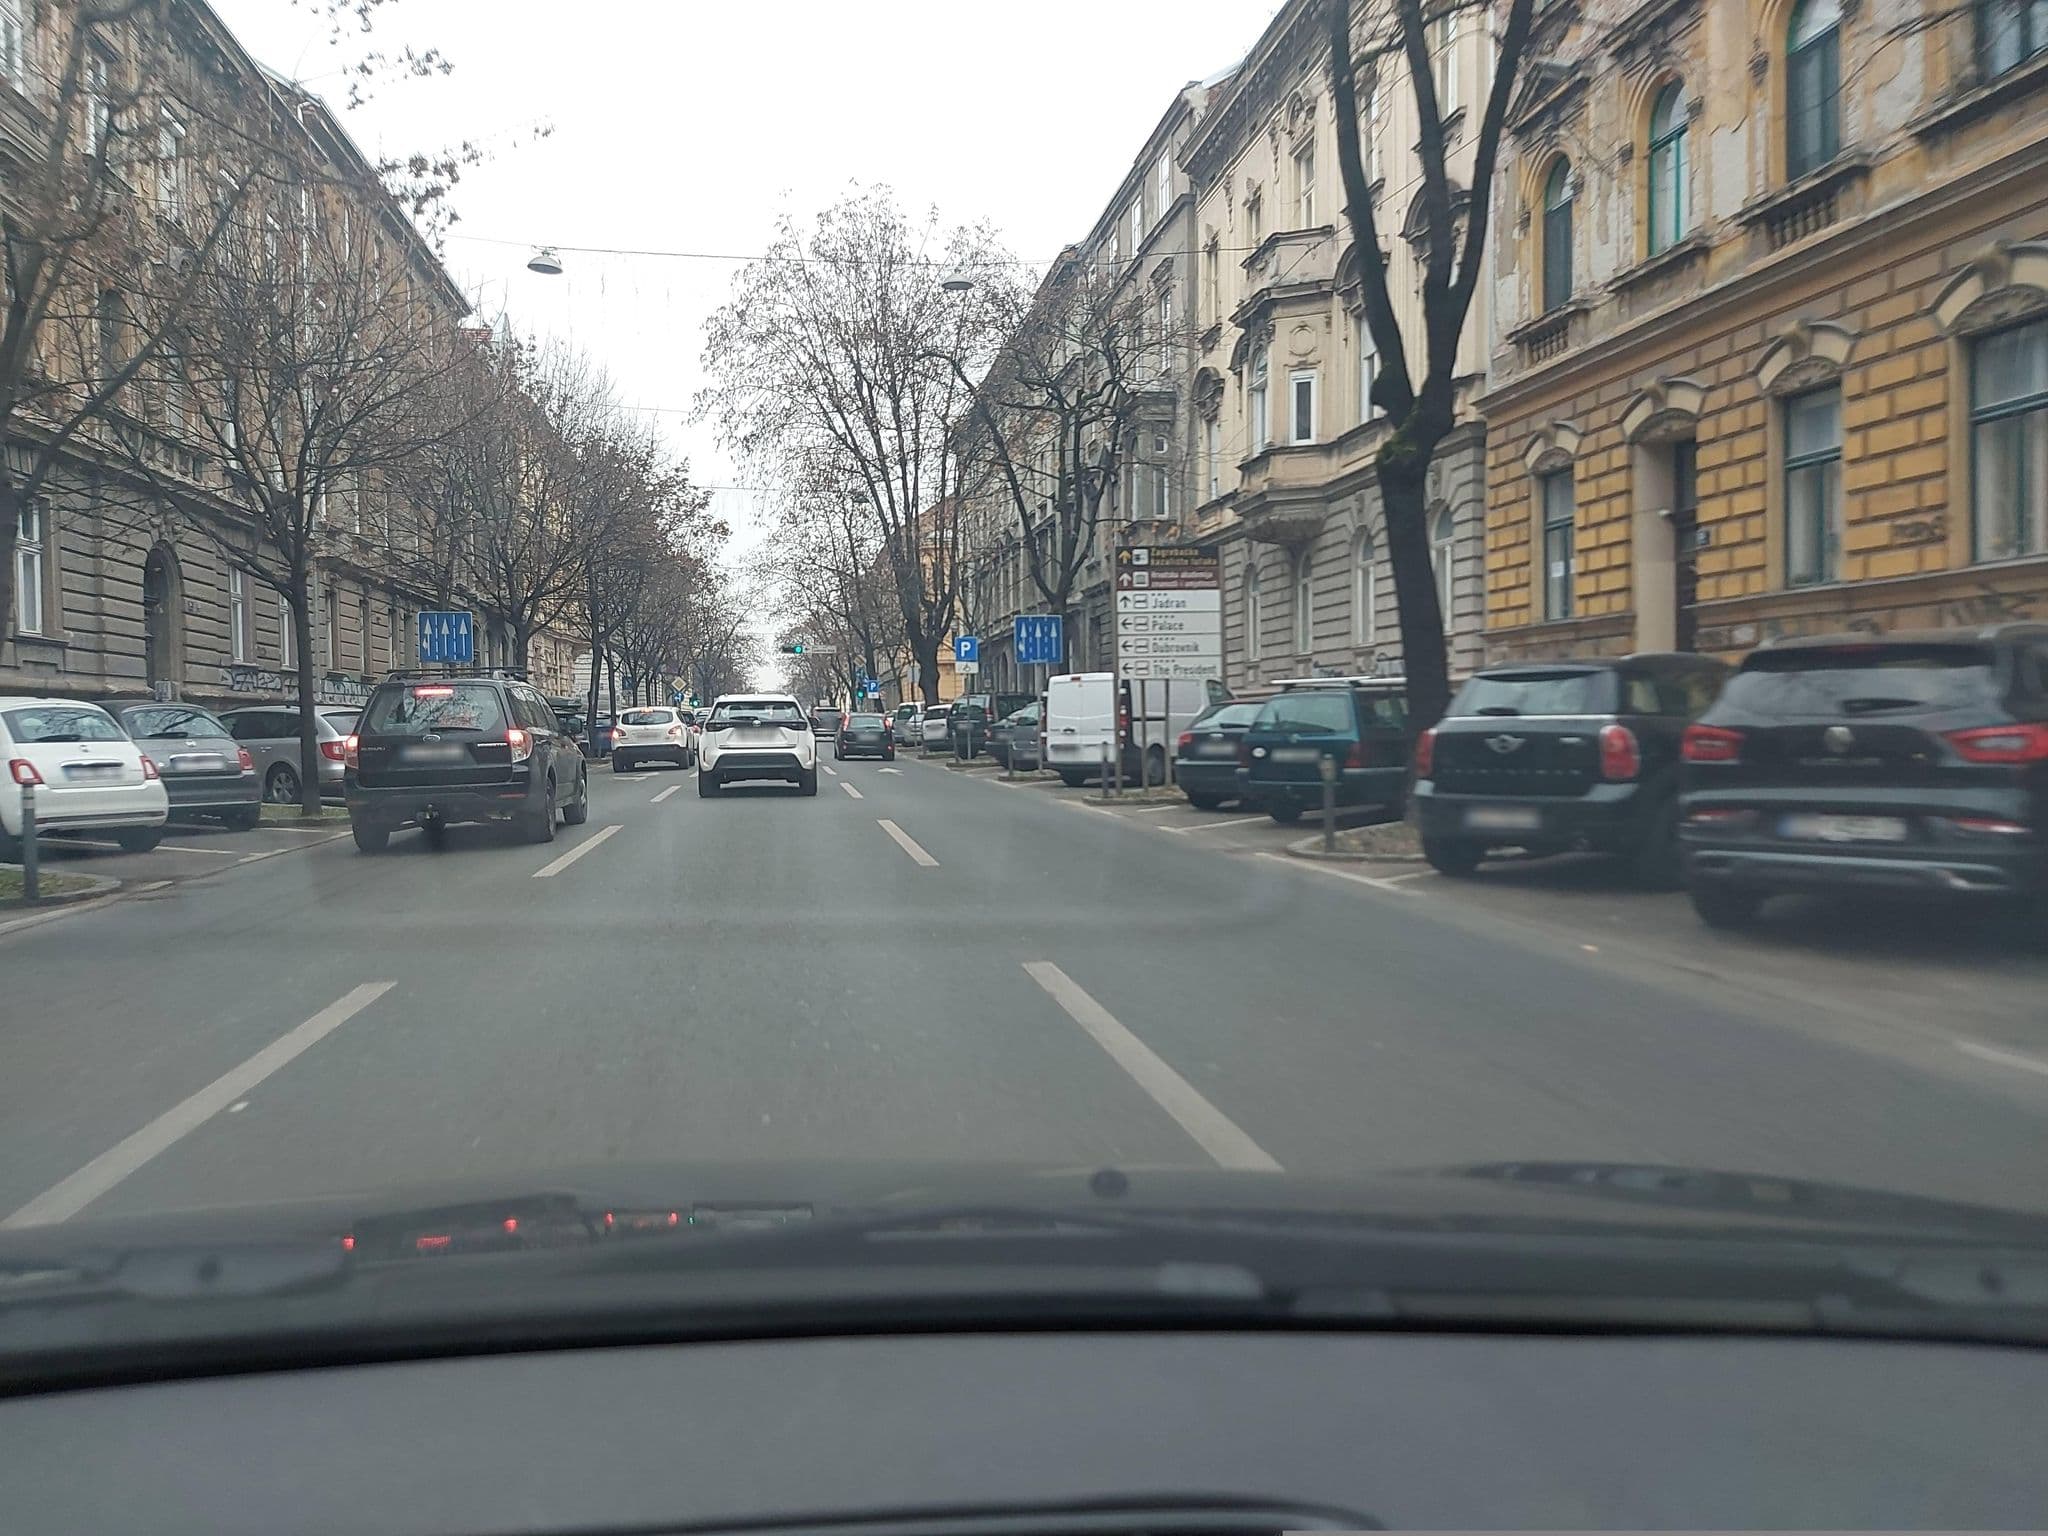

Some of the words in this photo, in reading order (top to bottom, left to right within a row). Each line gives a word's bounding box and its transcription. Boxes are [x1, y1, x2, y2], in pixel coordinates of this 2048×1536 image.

[1151, 598, 1186, 609] Jadran
[1152, 620, 1184, 631] Palace
[961, 641, 971, 657] P
[1152, 641, 1199, 652] Dubrovnik
[1153, 664, 1170, 675] The
[1173, 664, 1217, 675] President
